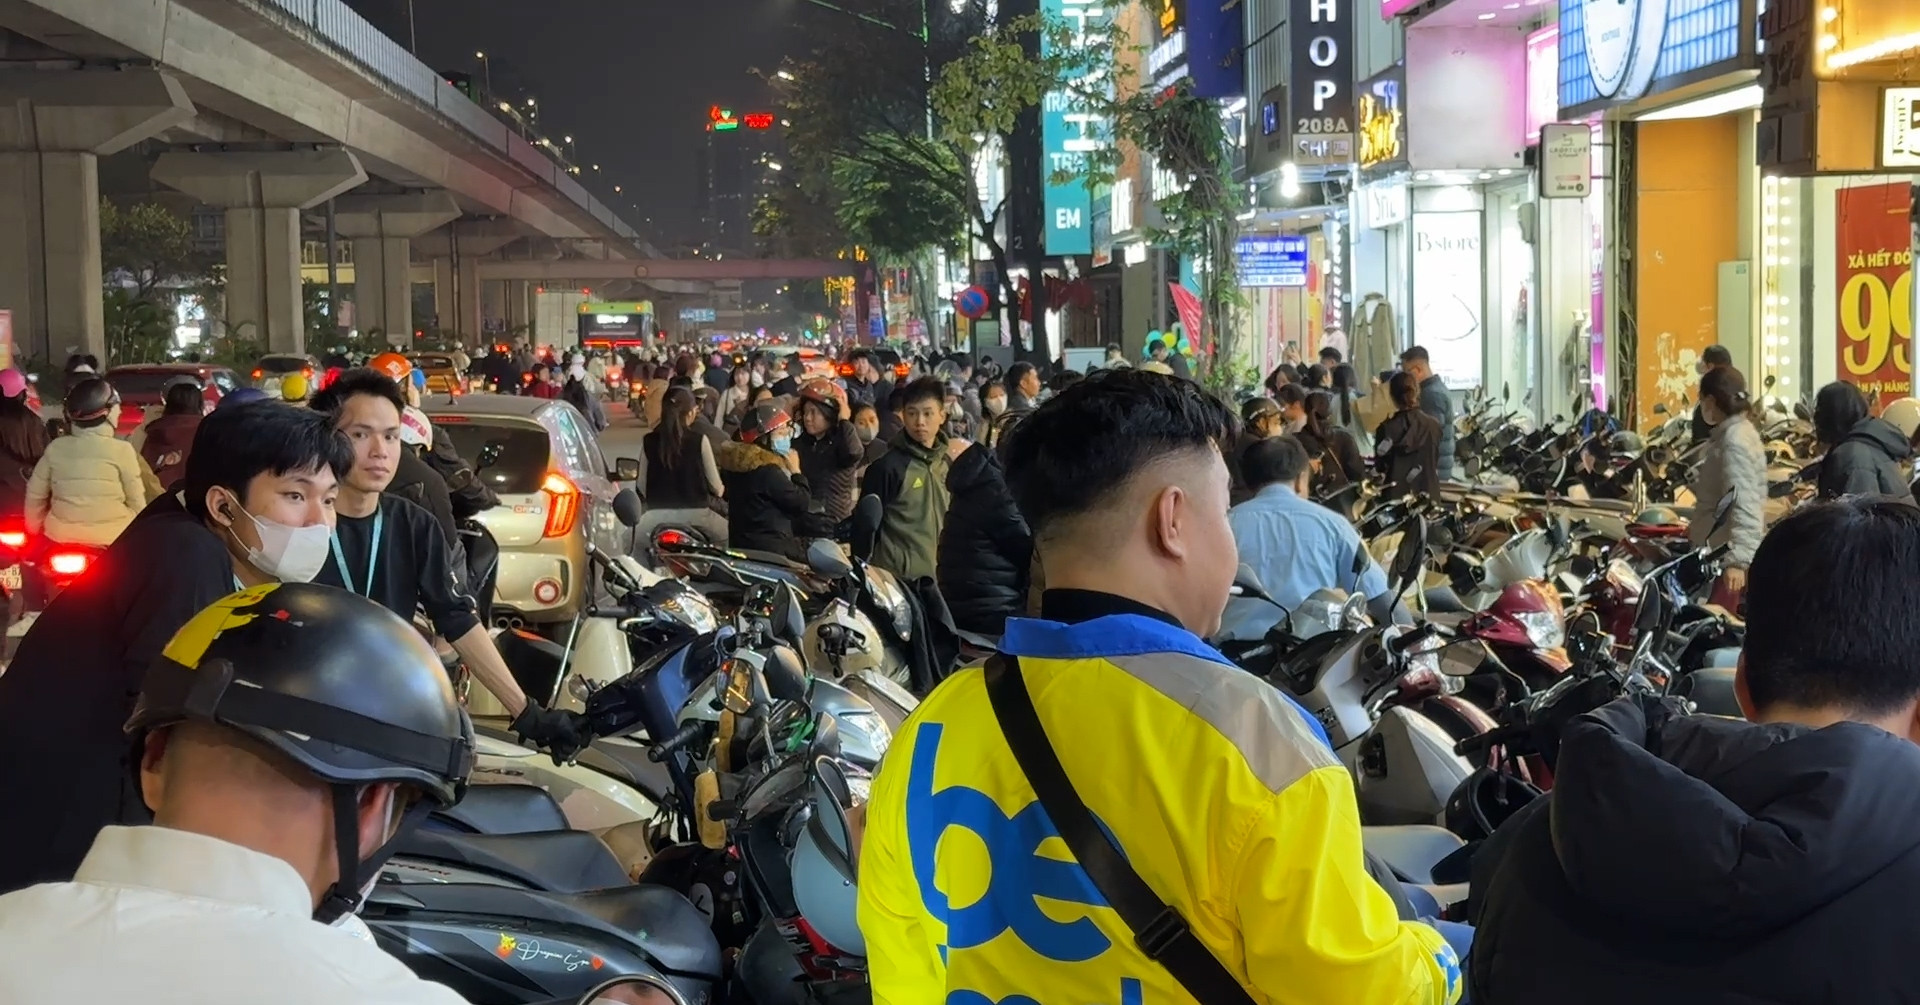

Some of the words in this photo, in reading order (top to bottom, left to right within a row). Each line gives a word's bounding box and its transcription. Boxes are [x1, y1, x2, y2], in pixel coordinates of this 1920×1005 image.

[1298, 117, 1348, 134] 208A
[1055, 207, 1081, 229] EM
[1848, 249, 1865, 269] XẢ
[1867, 247, 1891, 267] HẾT
[1884, 380, 1910, 393] HÀNG
[905, 722, 1131, 962] be
